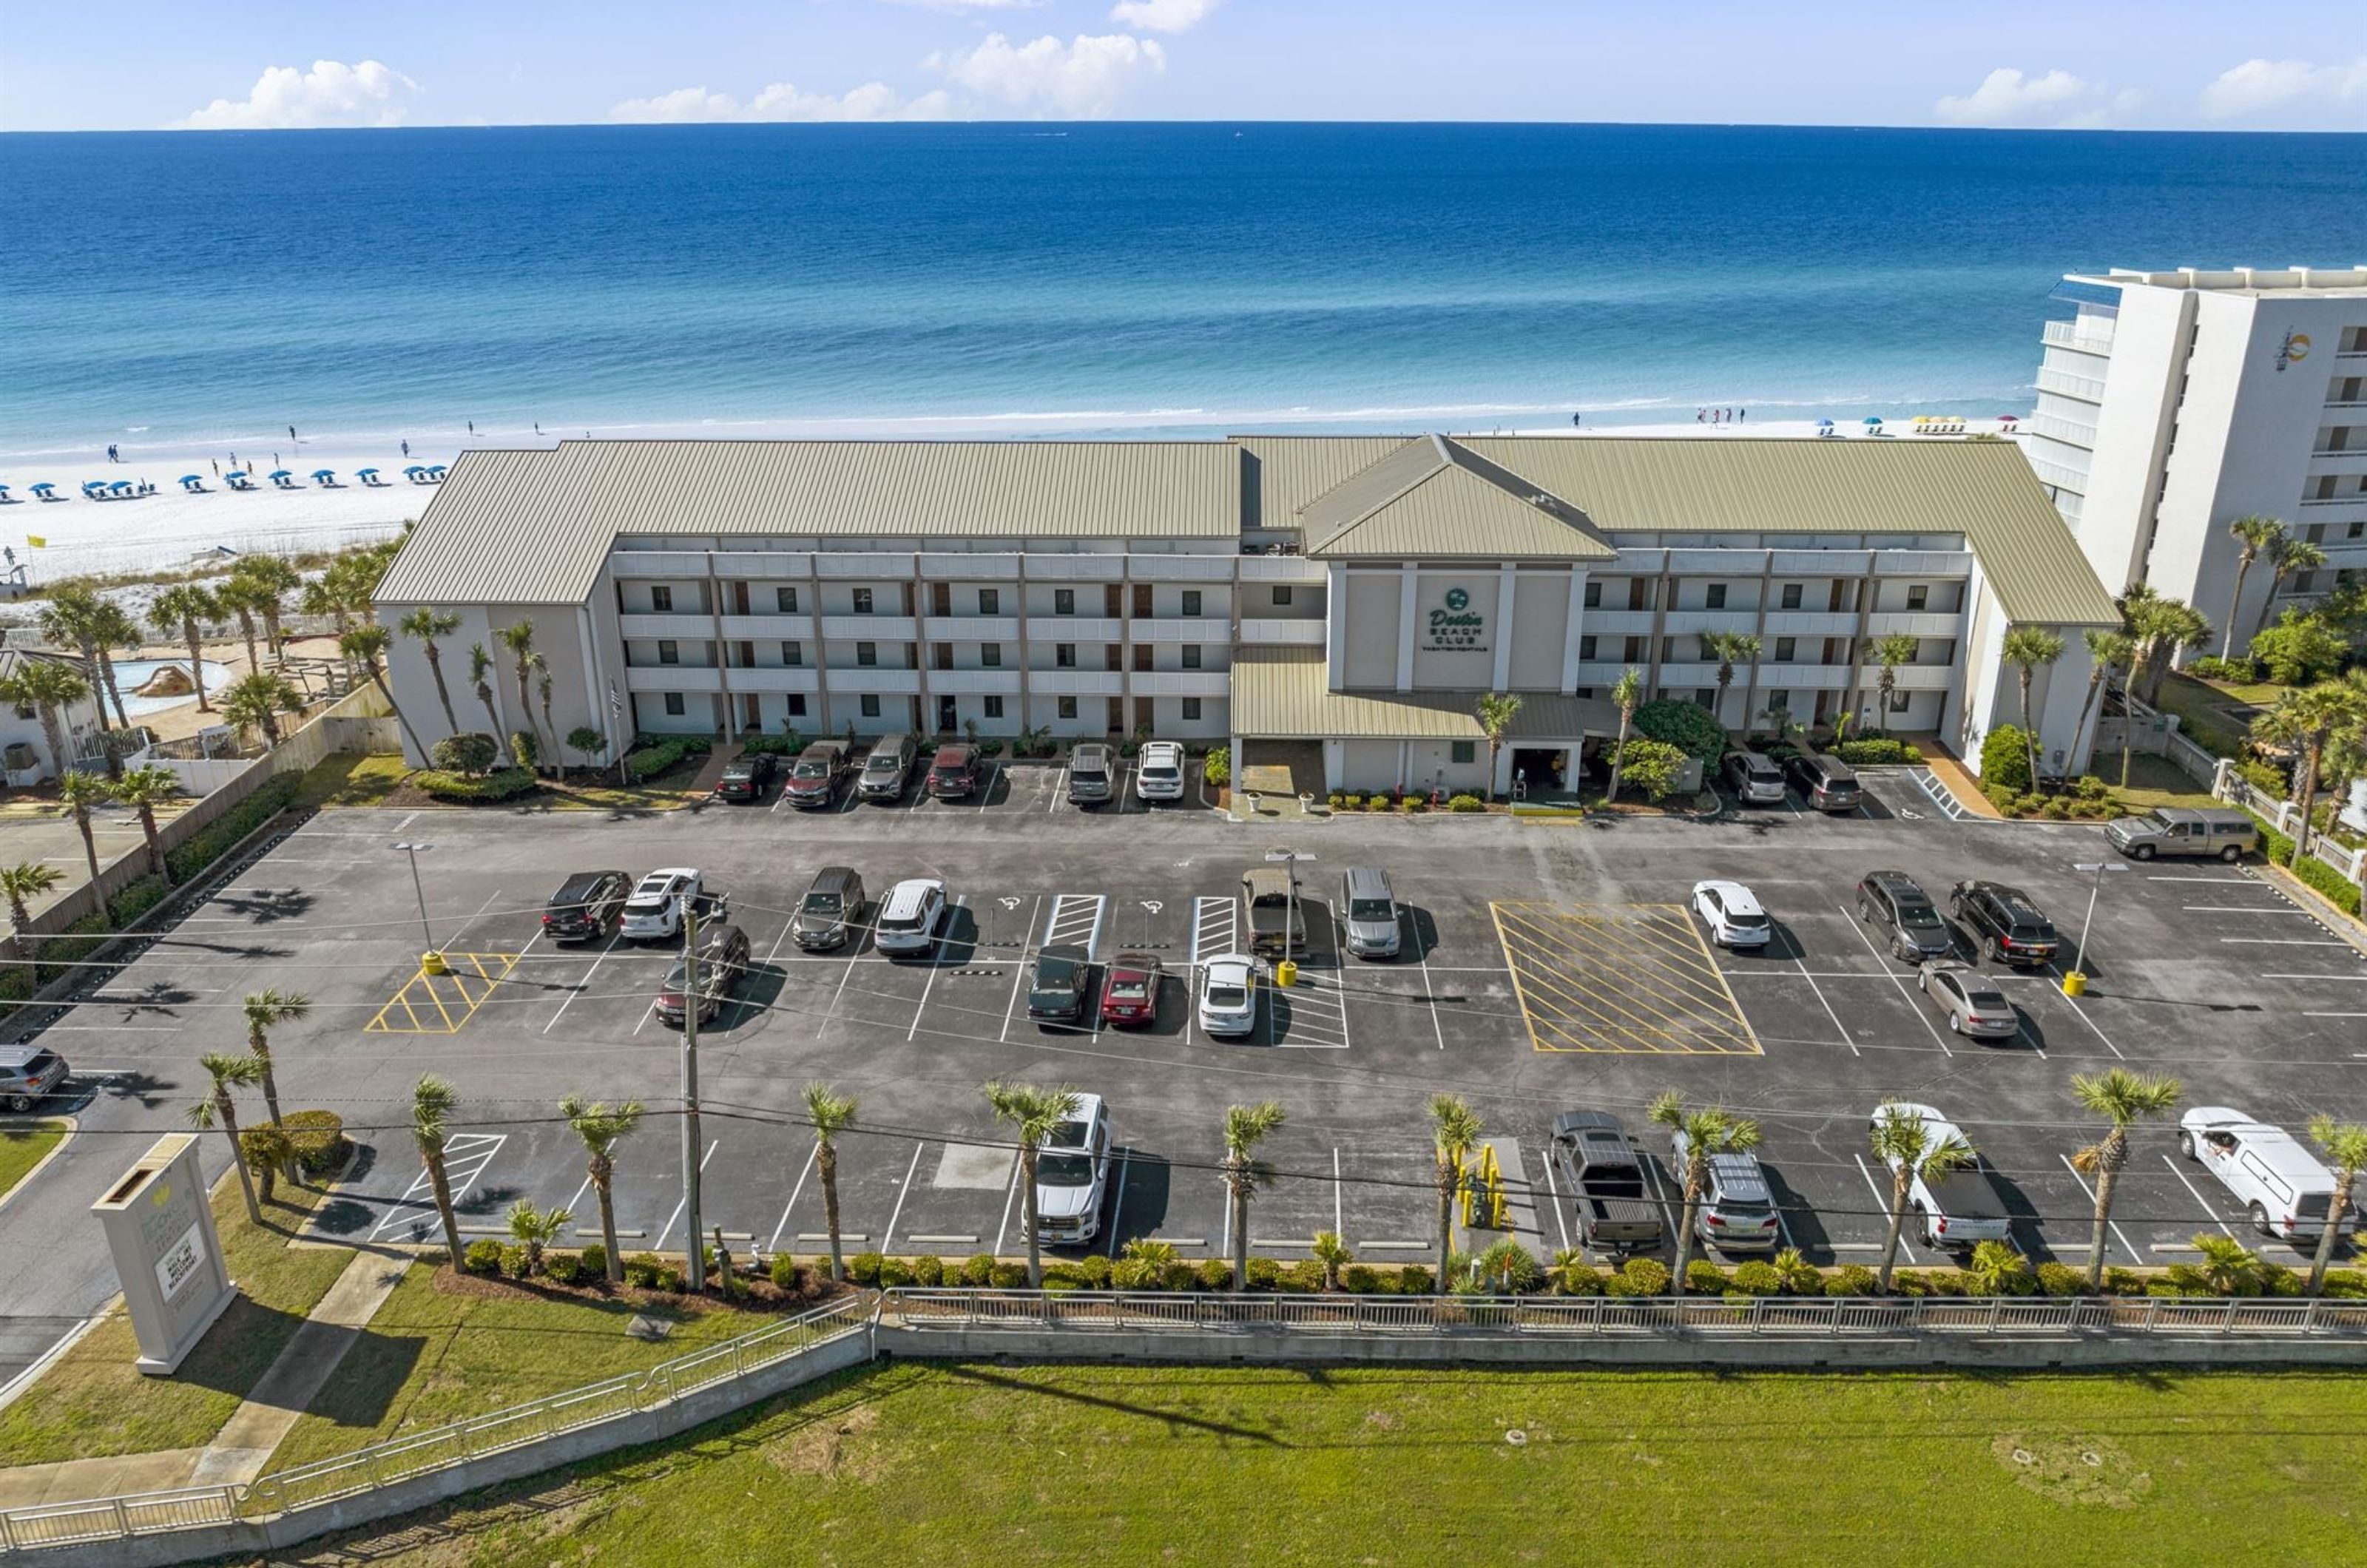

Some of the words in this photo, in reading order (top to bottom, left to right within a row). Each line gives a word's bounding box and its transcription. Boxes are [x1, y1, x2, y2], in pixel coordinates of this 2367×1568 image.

[1430, 609, 1482, 626] Destin
[167, 1256, 180, 1274] WALK
[168, 1254, 197, 1291] BEACHFRONT
[170, 1251, 192, 1280] WELCOME
